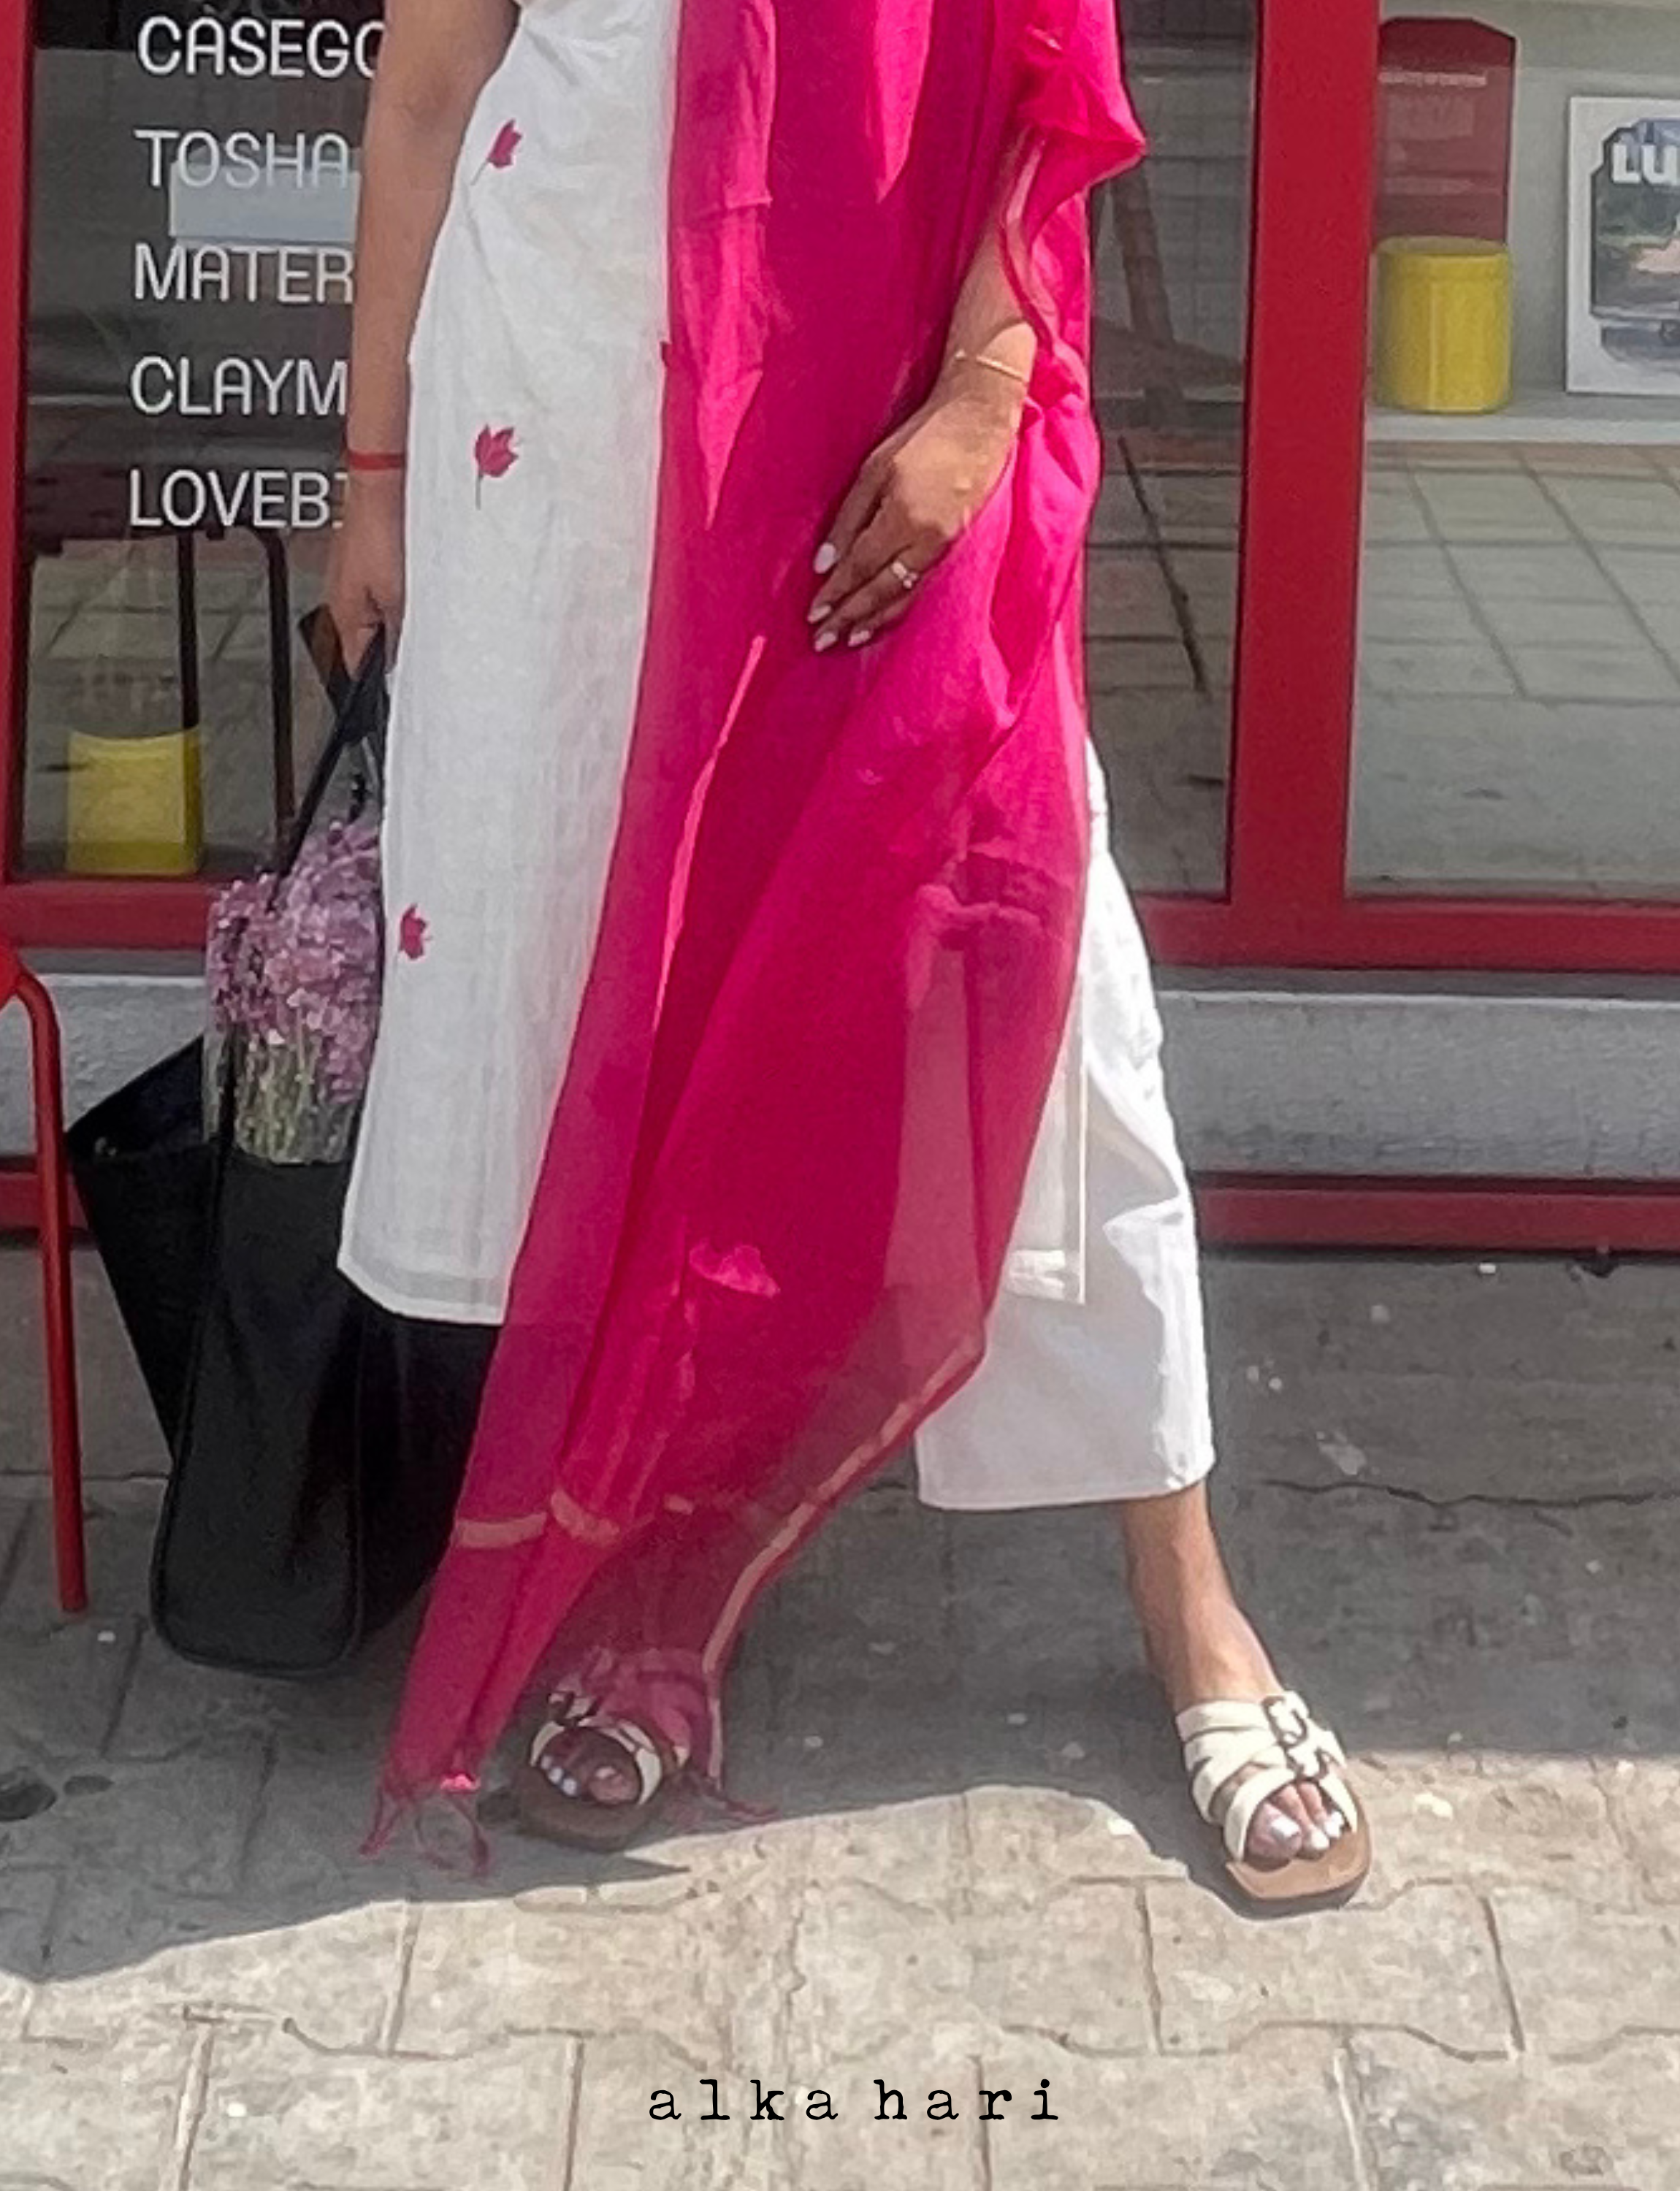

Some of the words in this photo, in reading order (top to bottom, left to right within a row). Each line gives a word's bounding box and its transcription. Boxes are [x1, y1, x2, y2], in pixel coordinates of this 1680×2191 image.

[135, 129, 348, 189] TOSHA
[134, 242, 354, 305] MATER
[131, 356, 347, 416] CLAYM
